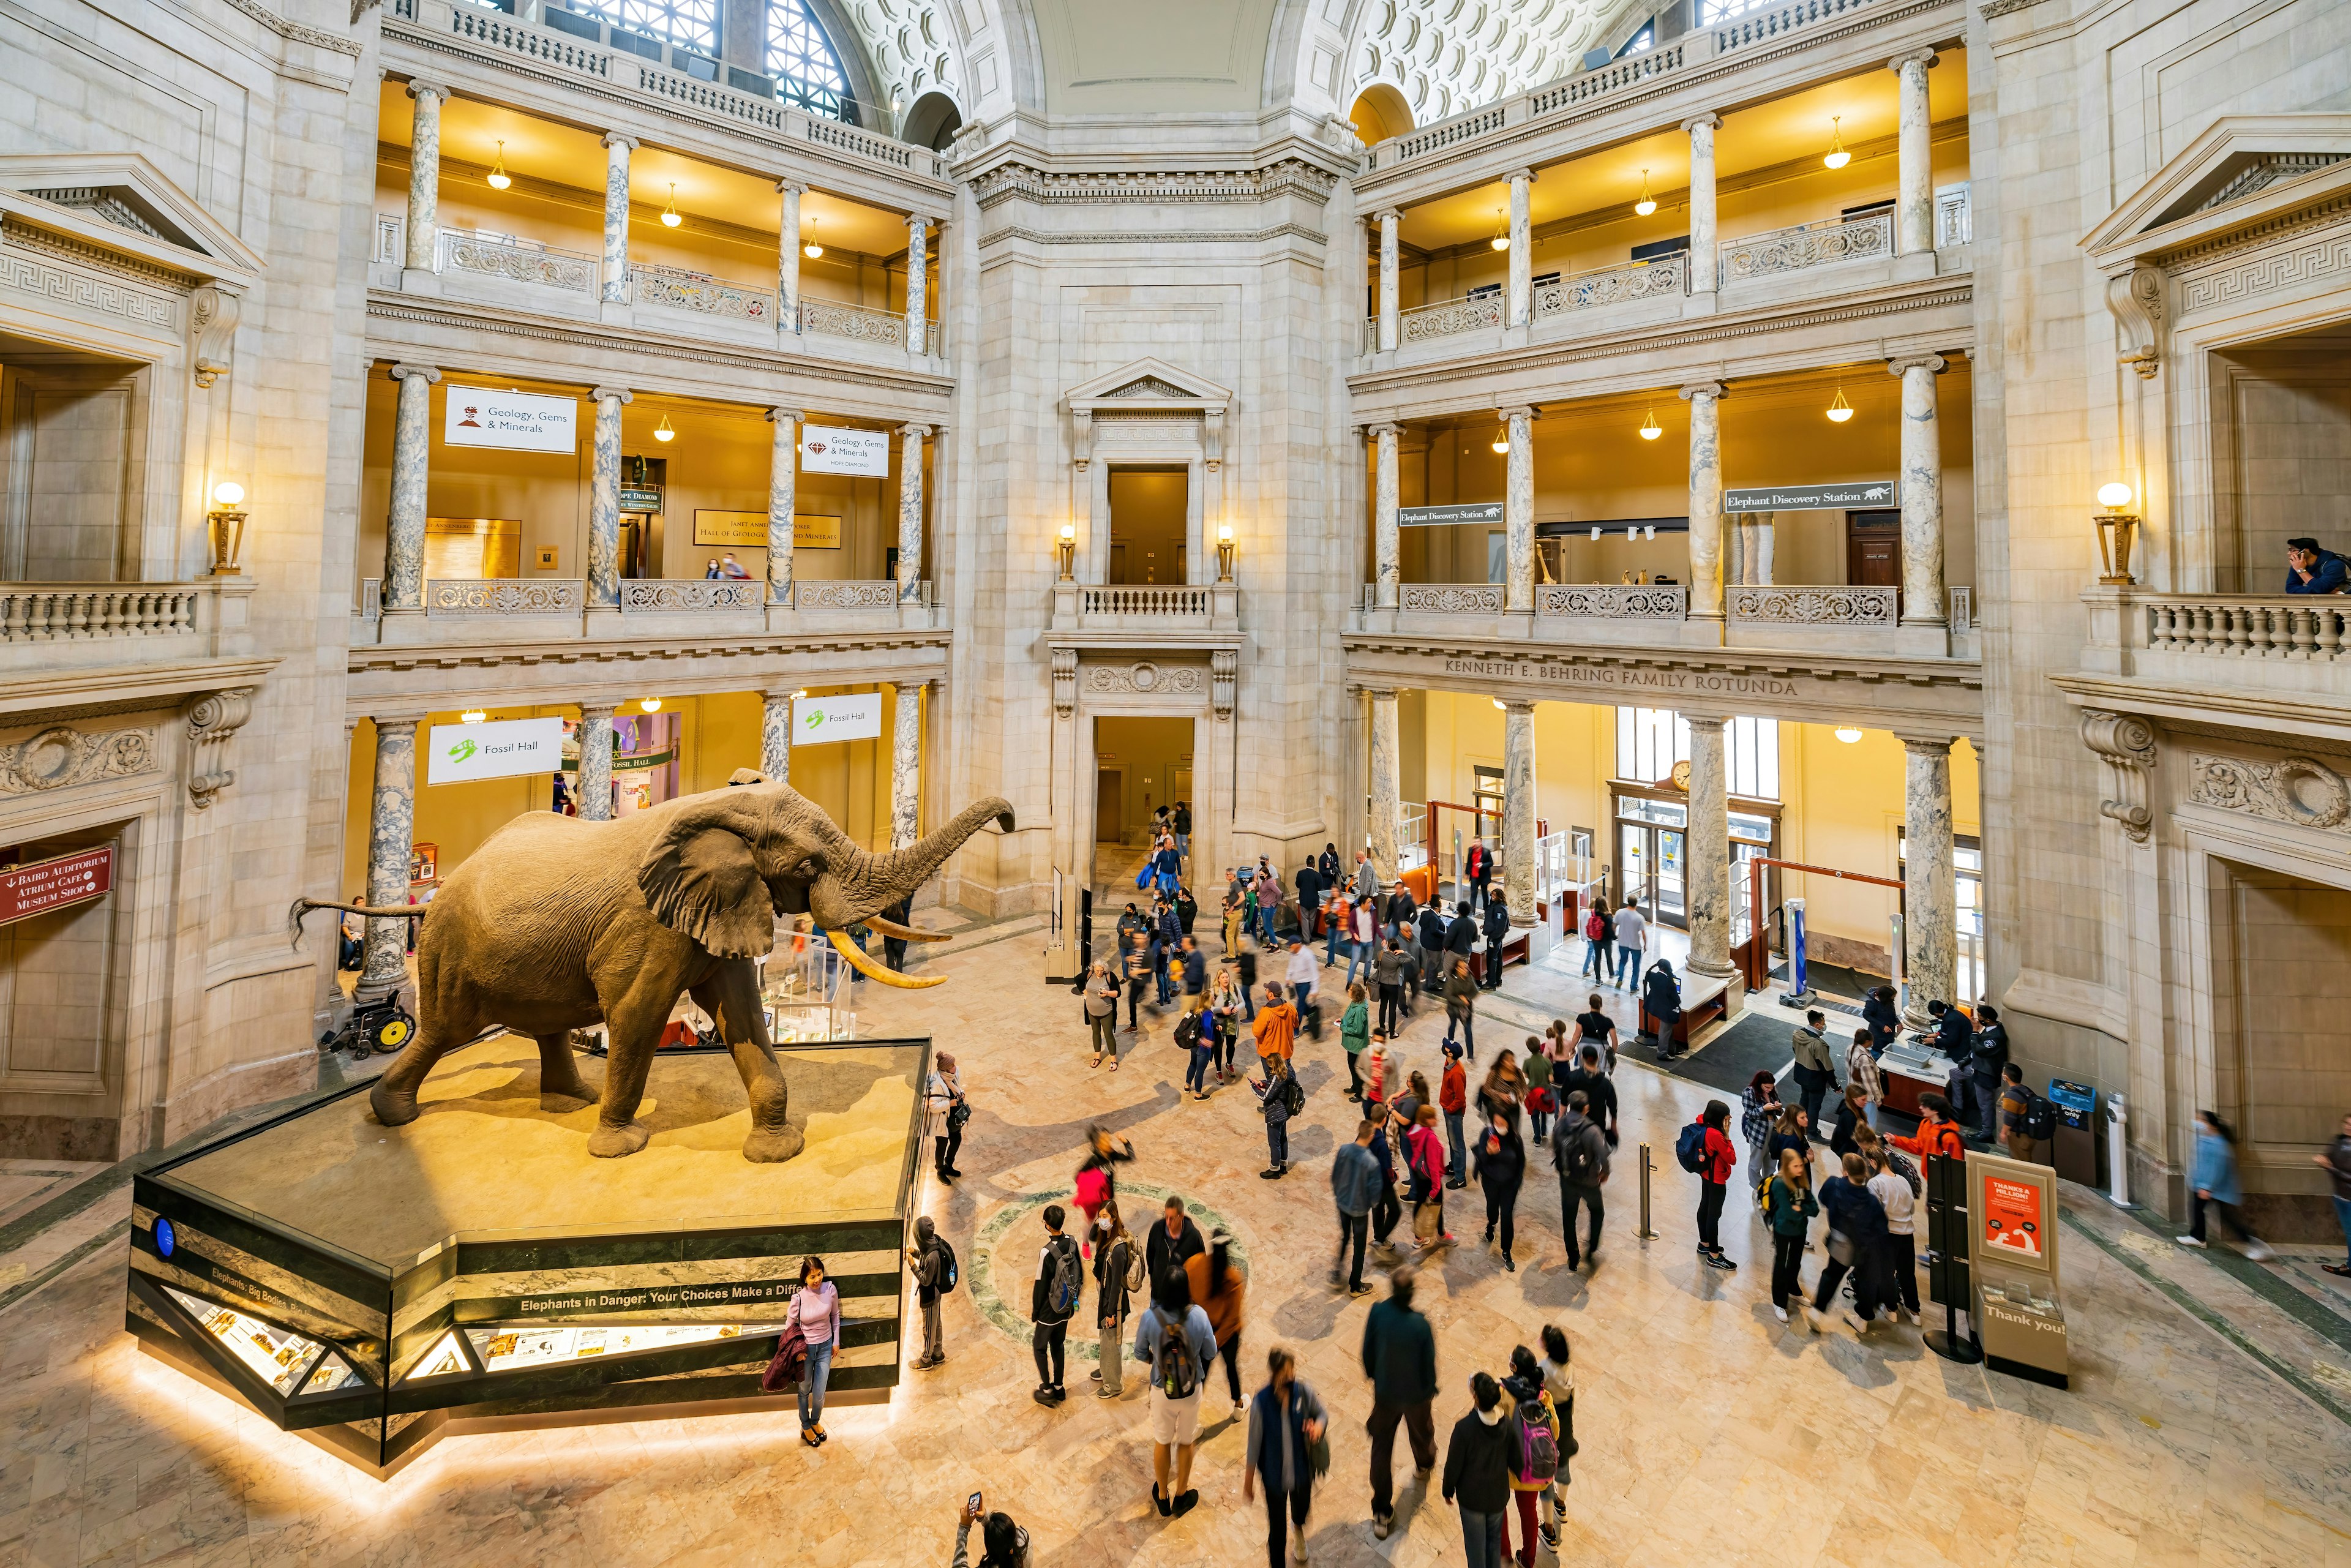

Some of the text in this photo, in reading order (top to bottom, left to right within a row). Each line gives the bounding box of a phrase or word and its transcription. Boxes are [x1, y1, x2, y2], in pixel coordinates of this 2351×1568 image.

[489, 407, 568, 422] Geology, Gems
[488, 420, 542, 433] & Minerals
[831, 437, 862, 448] Geology,
[839, 448, 868, 457] Minerals
[633, 492, 658, 501] DIAMOND
[1727, 492, 1861, 509] Elephant Discovery Station
[1401, 513, 1428, 523] Elephant
[1429, 512, 1460, 521] Discovery
[1445, 660, 1798, 696] KENNETH E. BEHRING FAMILY ROTUNDA
[830, 714, 849, 722] Fossil
[486, 741, 538, 754] Fossil Hall
[18, 855, 107, 886] BAIRD AUDITORIUM
[17, 872, 83, 898] ATRIUM CAFÉ
[16, 885, 85, 912] MUSEUM SHOP
[2061, 1105, 2082, 1114] paper
[2064, 1111, 2080, 1120] only
[1993, 1182, 2023, 1193] THANKS
[1996, 1188, 2028, 1200] MILLION!
[212, 1267, 247, 1292] Elephants:
[249, 1284, 261, 1300] Big
[521, 1297, 582, 1312] Elephants
[585, 1297, 596, 1307] in
[599, 1294, 647, 1307] Danger:
[650, 1292, 678, 1302] Your
[681, 1289, 729, 1300] Choices
[732, 1286, 762, 1298] Make
[1984, 1305, 2066, 1335] Thank you!
